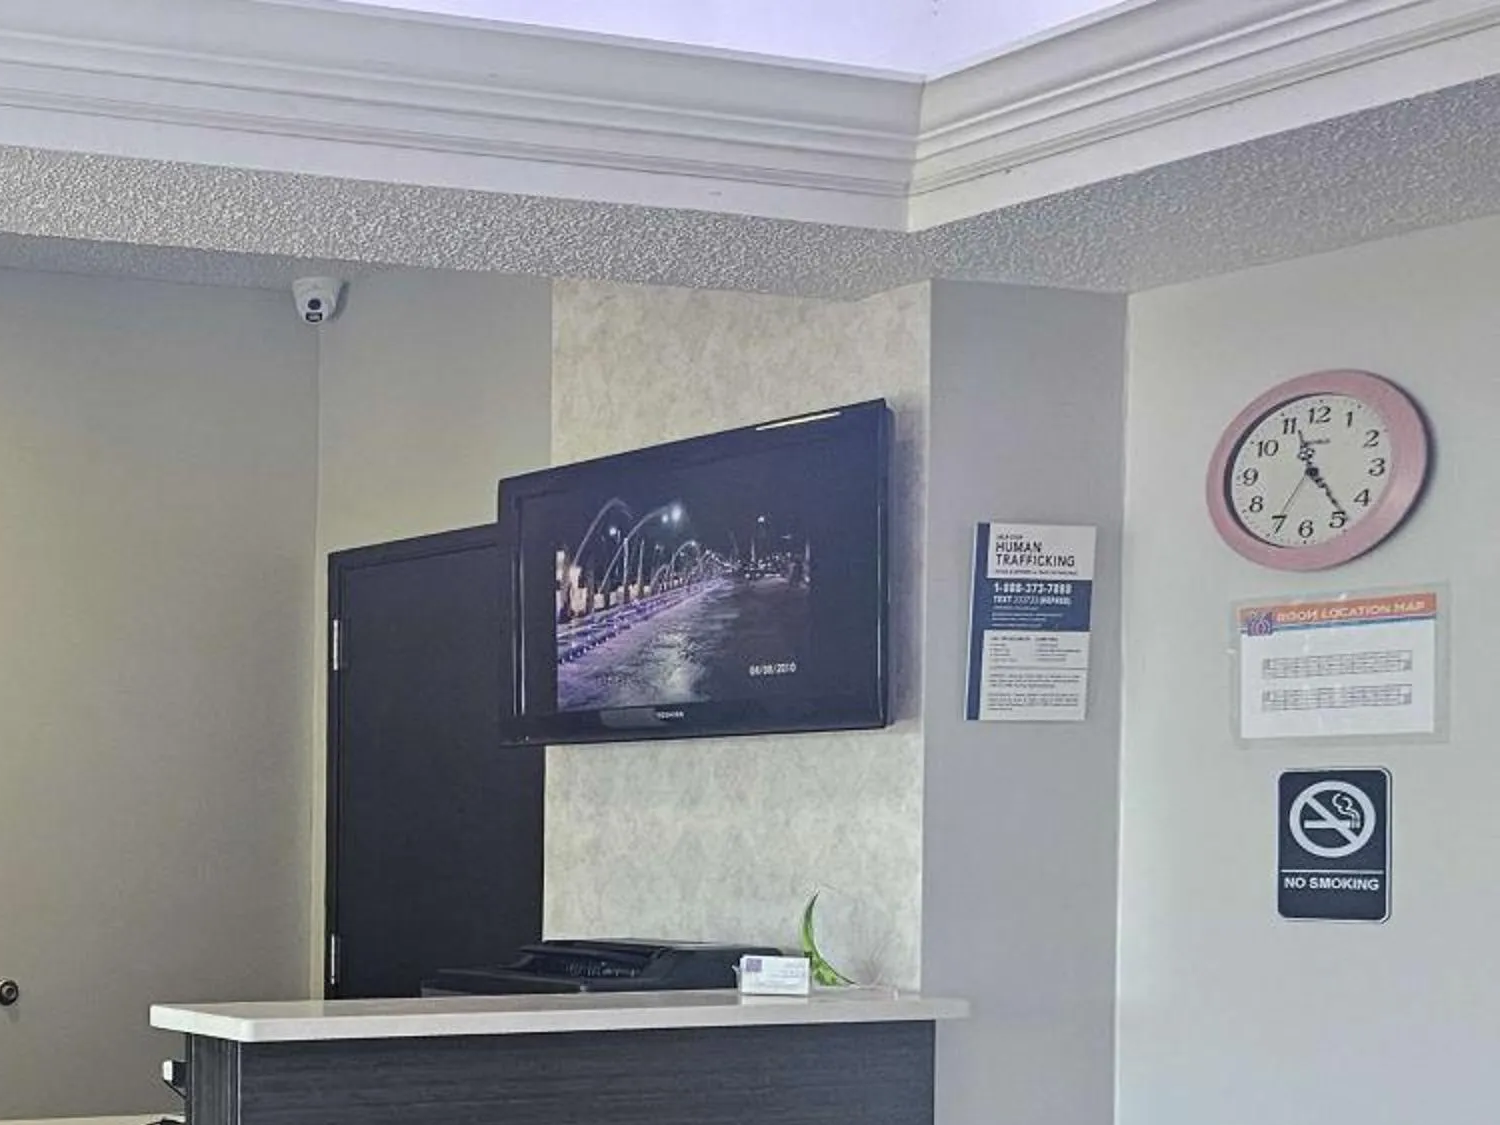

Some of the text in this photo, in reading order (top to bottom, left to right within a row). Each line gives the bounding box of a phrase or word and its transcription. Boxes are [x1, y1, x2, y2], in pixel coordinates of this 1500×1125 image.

[1308, 406, 1331, 425] 12
[1346, 411, 1354, 428] 1
[1282, 417, 1297, 434] 11
[1363, 430, 1380, 448] 2
[1257, 440, 1279, 457] 10
[1368, 458, 1386, 476] 3
[1243, 468, 1259, 486] 9
[1249, 496, 1264, 513] 8
[1353, 488, 1371, 507] 4
[1272, 514, 1287, 534] 7
[1299, 520, 1314, 538] 6
[1329, 511, 1347, 529] 5
[995, 541, 1042, 553] HUMAN
[996, 554, 1075, 567] TRAFFICKING
[993, 595, 1012, 603] TEXT
[1277, 601, 1425, 622] ROOM LOCATION MAP
[1284, 877, 1380, 891] NO SMOKING
